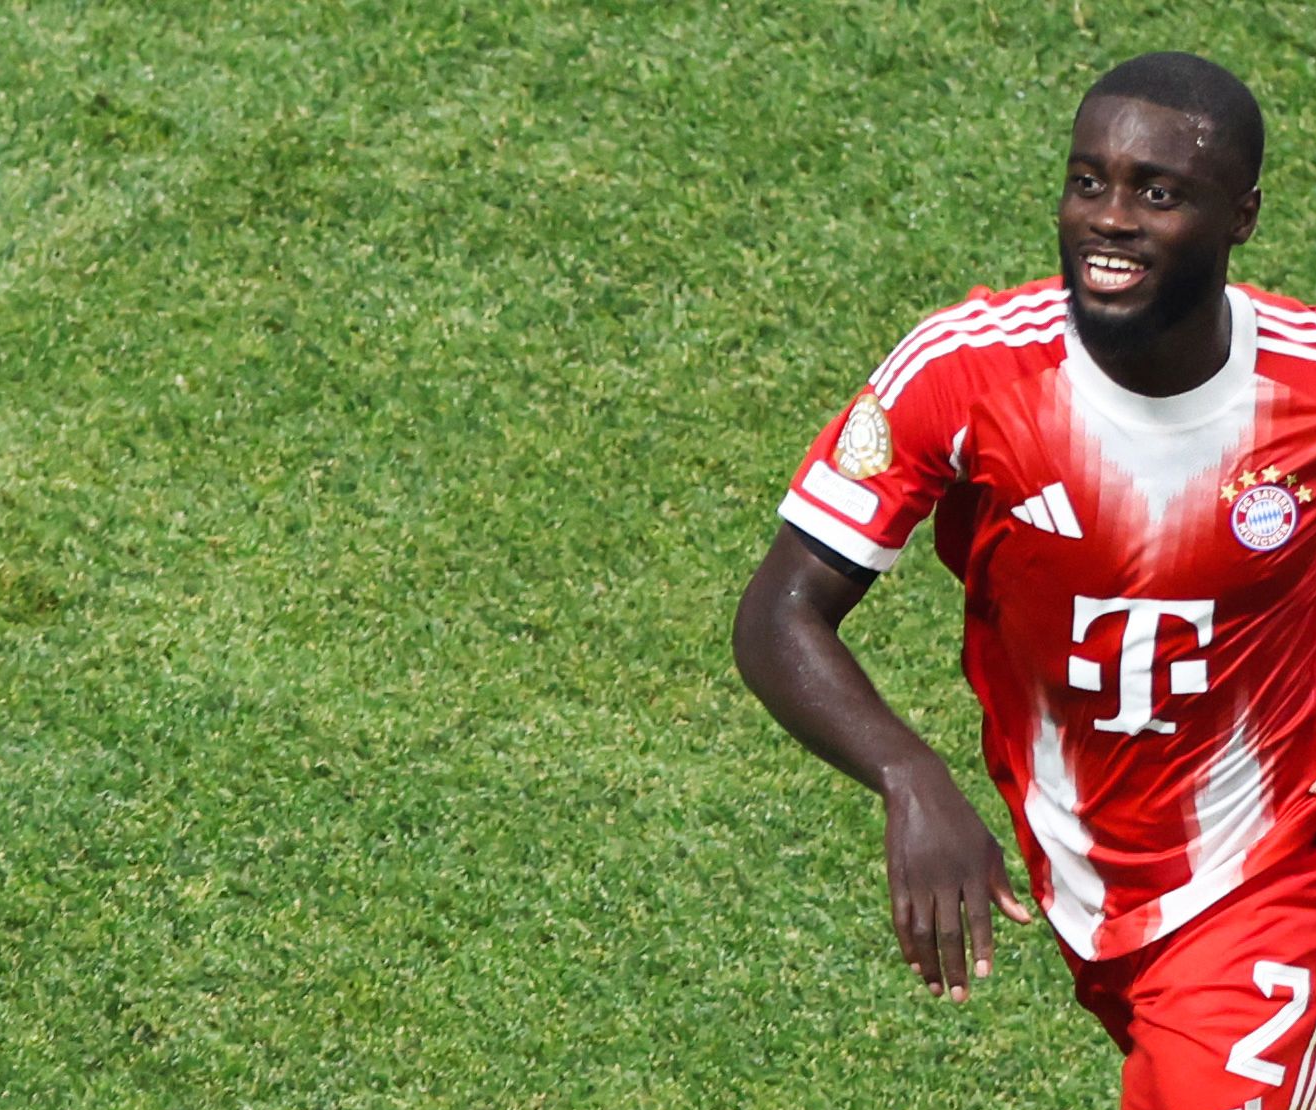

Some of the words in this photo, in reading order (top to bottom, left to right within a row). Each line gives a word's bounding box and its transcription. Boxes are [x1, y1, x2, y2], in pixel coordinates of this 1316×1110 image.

[839, 452, 861, 474] FIFA
[1238, 496, 1254, 513] FC
[1252, 489, 1292, 514] BAYERN
[1068, 594, 1215, 736] T
[1225, 960, 1310, 1087] 2
